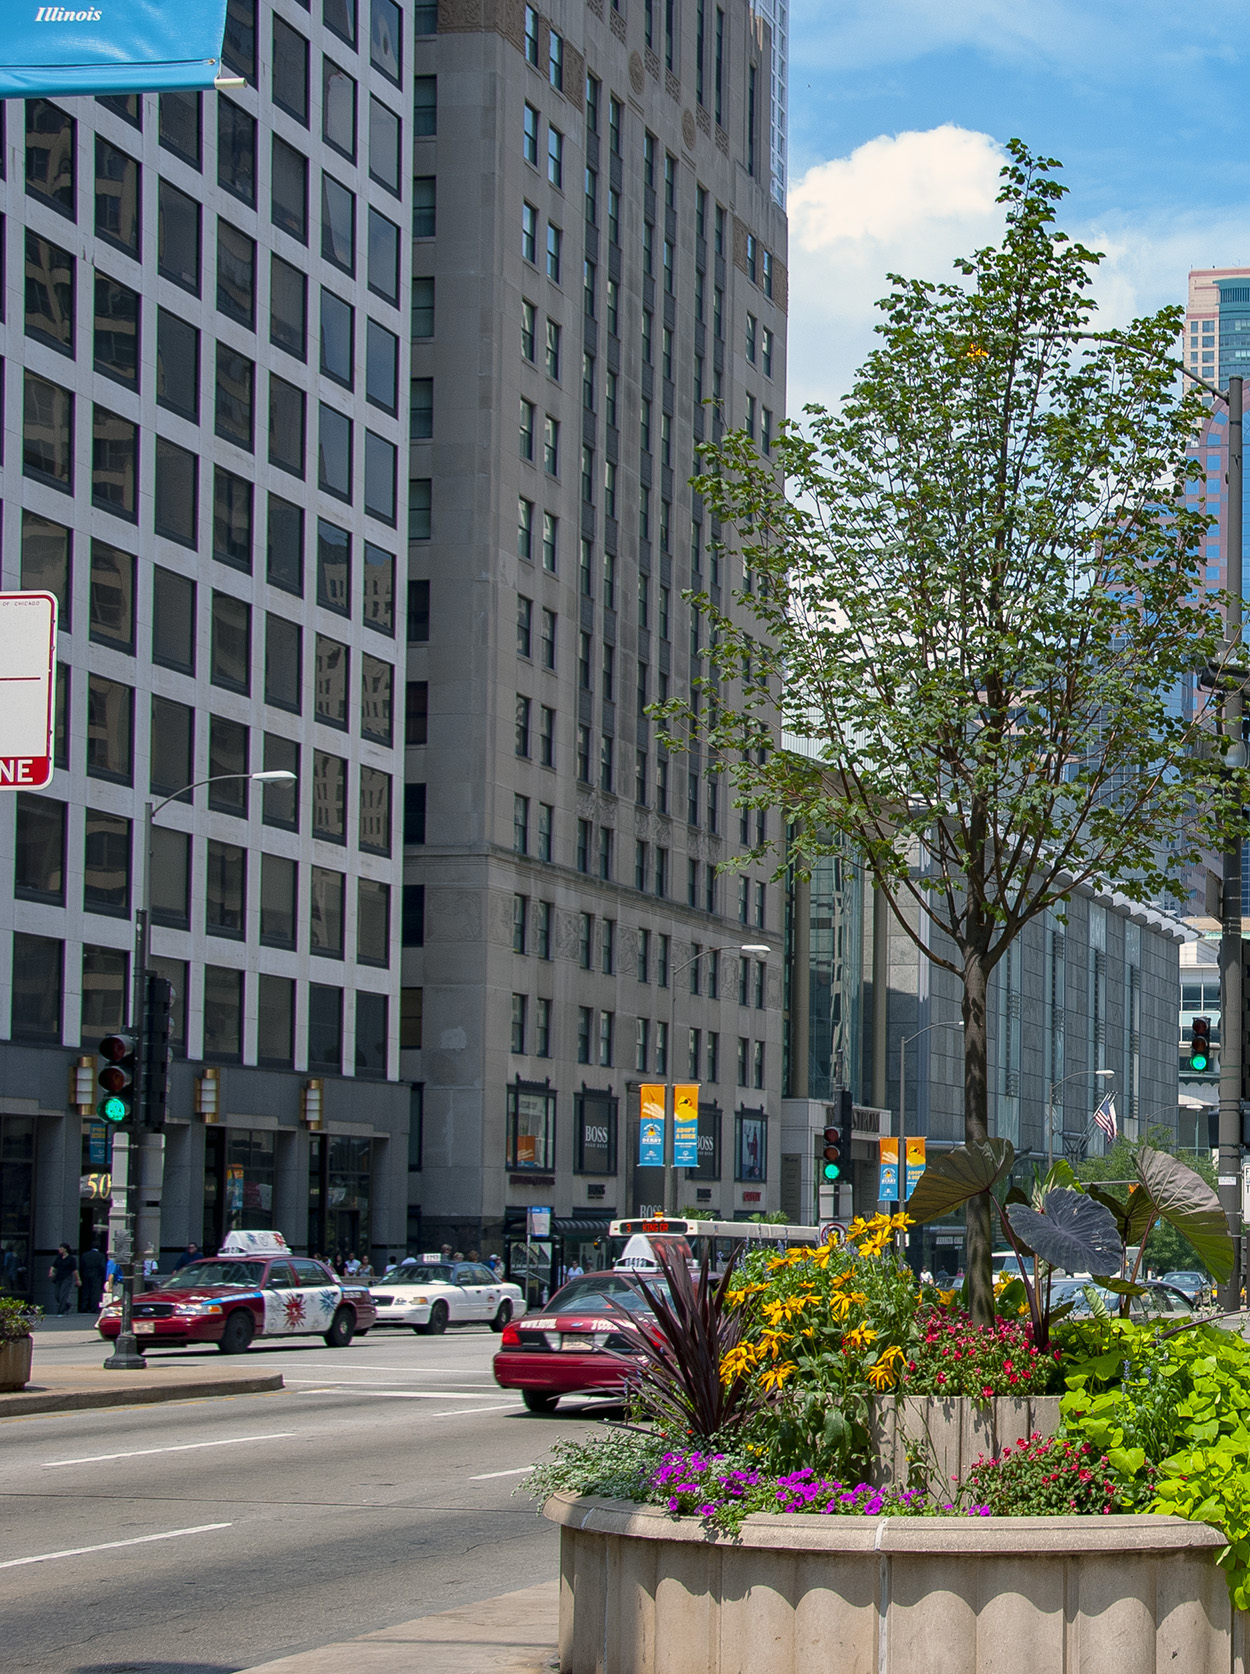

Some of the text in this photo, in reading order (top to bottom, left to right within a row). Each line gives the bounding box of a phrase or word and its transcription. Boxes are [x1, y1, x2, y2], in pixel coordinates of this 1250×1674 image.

[35, 6, 102, 22] Illinois
[585, 1125, 608, 1143] BOSS
[625, 1223, 632, 1233] 3
[642, 1223, 659, 1232] KING
